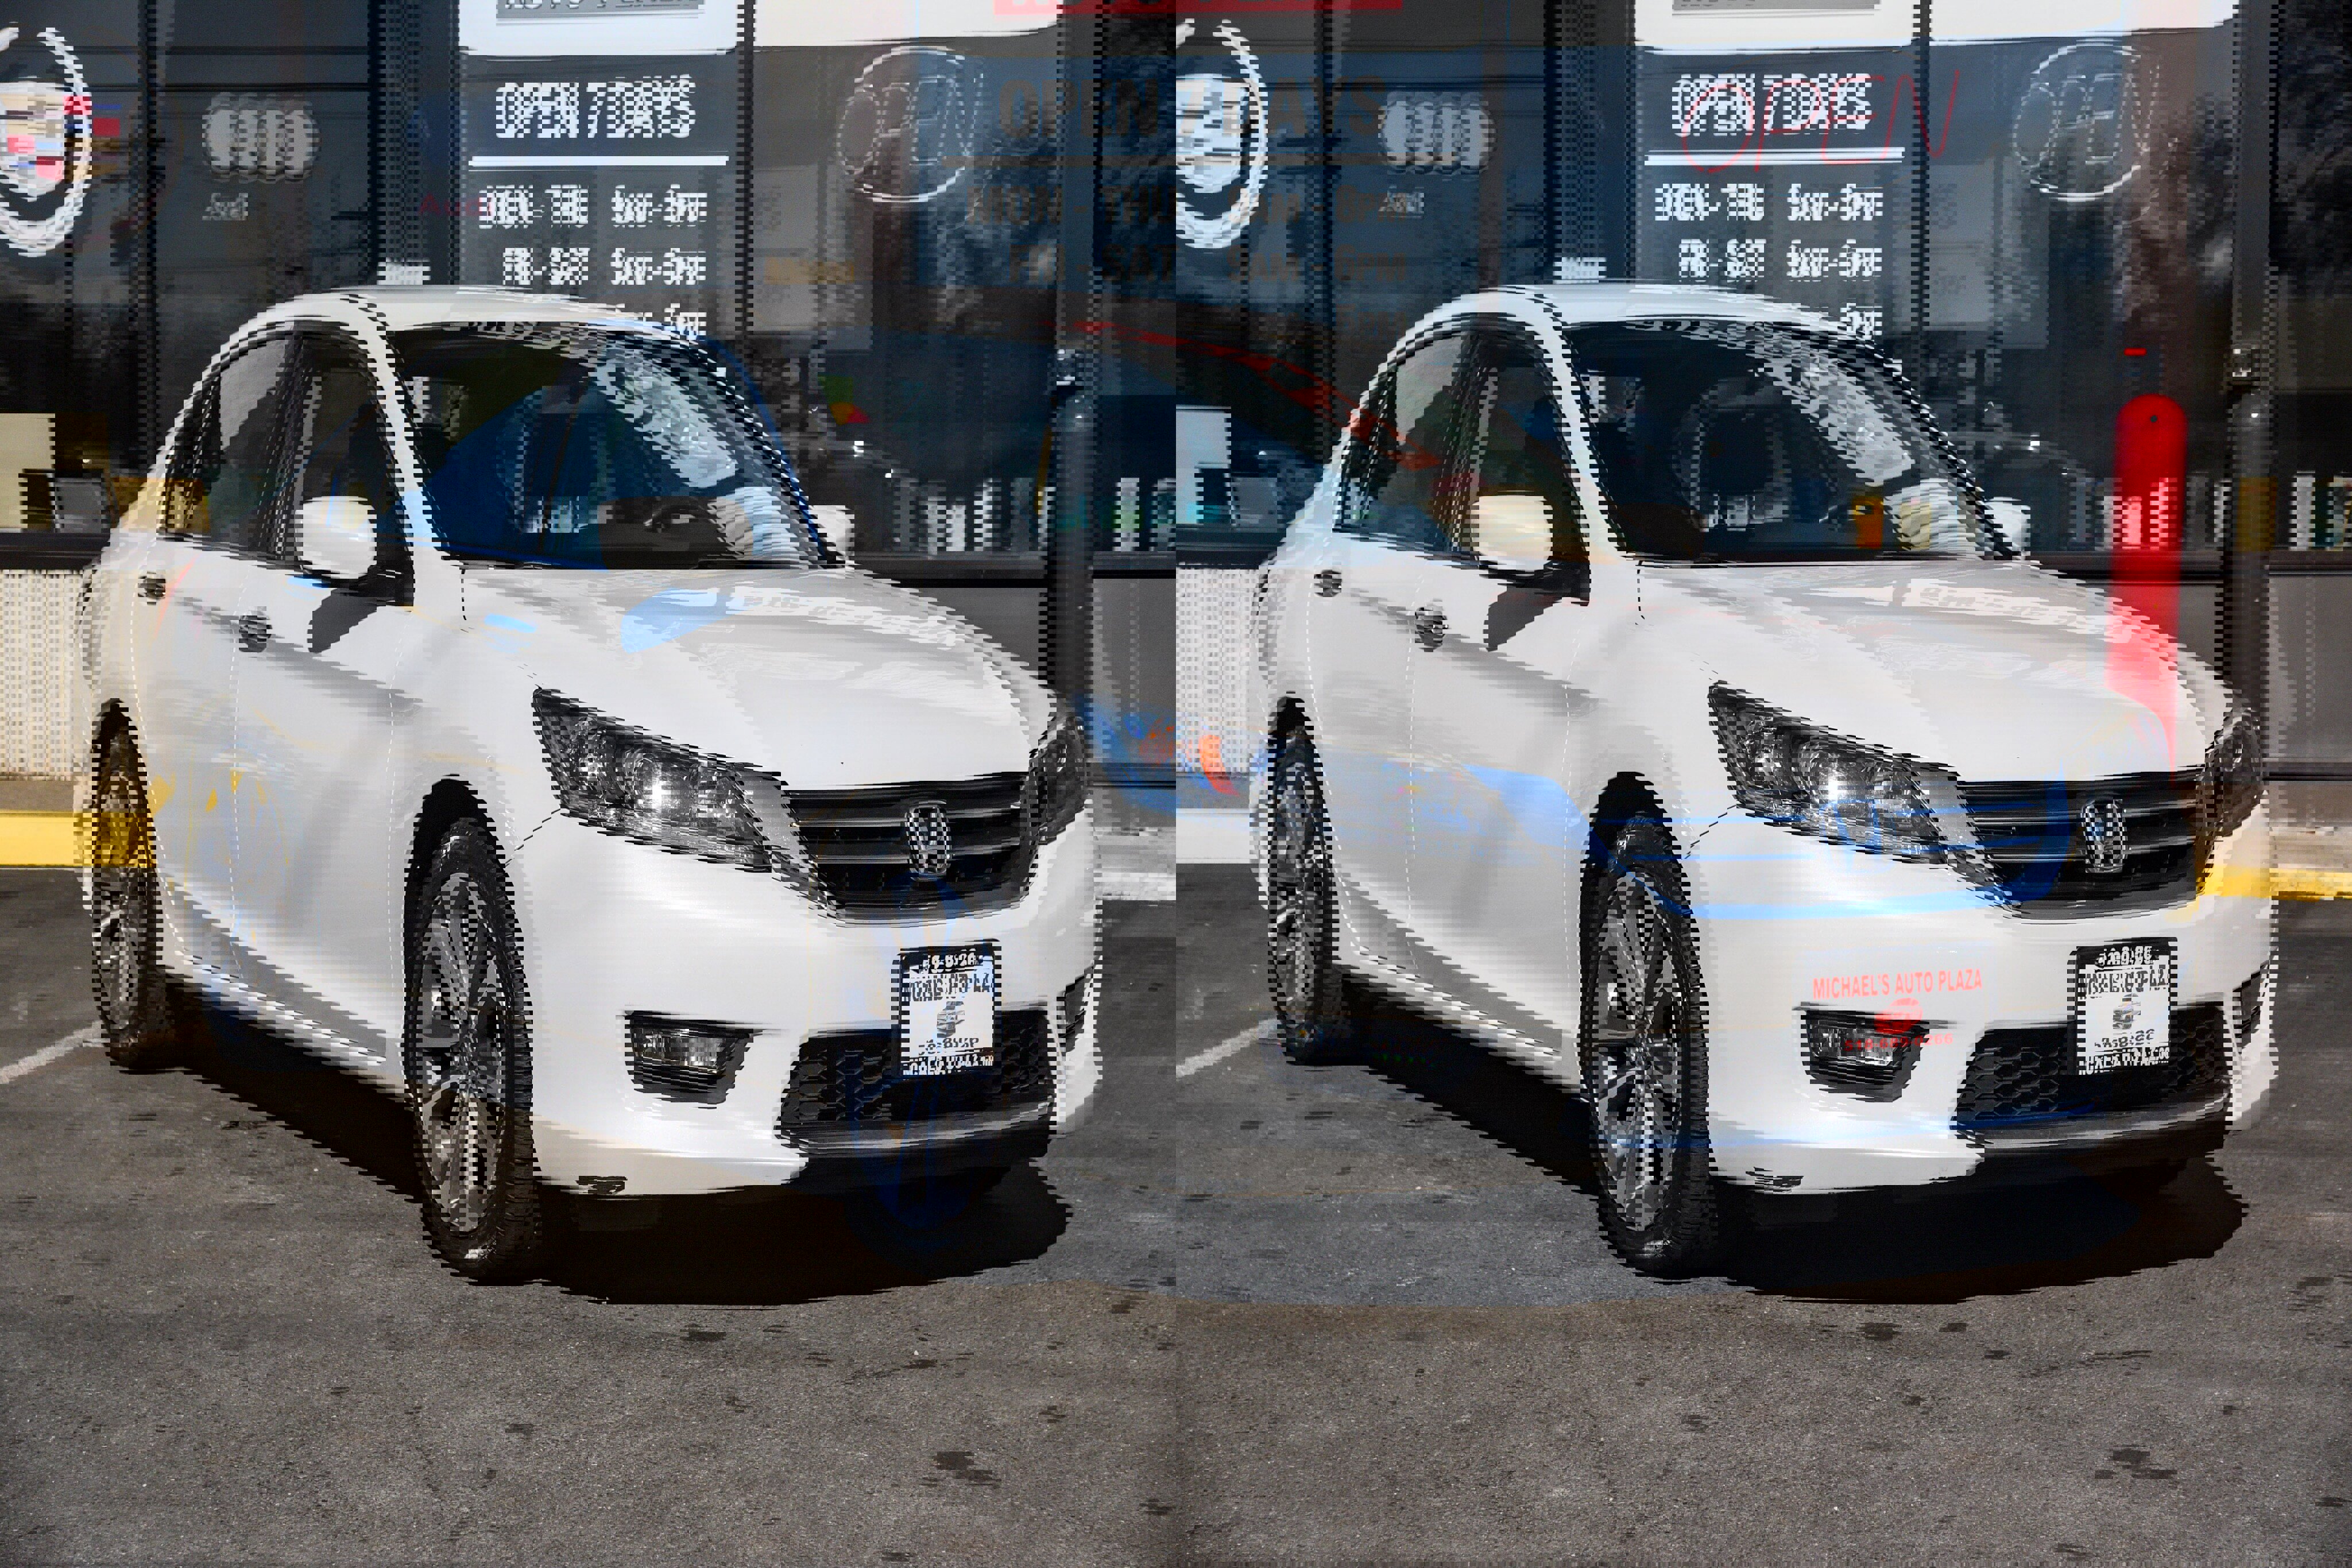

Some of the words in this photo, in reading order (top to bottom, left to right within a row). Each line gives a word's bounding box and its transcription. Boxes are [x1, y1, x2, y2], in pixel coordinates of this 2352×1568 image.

[999, 78, 1158, 138] OPEN
[1175, 78, 1205, 137] 7
[1223, 74, 1386, 136] DAYS
[1681, 69, 1960, 173] OPEN
[417, 192, 493, 216] Audi
[966, 185, 1063, 225] MON
[1097, 185, 1178, 224] THU
[1336, 185, 1407, 223] 8PM
[1008, 243, 1065, 282] FRI
[1100, 243, 1179, 282] SAT
[1334, 243, 1406, 282] 6PM
[1812, 973, 1891, 1000] MICHAEL'S
[1894, 970, 1934, 995] AUTO
[1937, 967, 1983, 992] PLAZA
[1843, 1033, 1953, 1052] 518-689-0266
